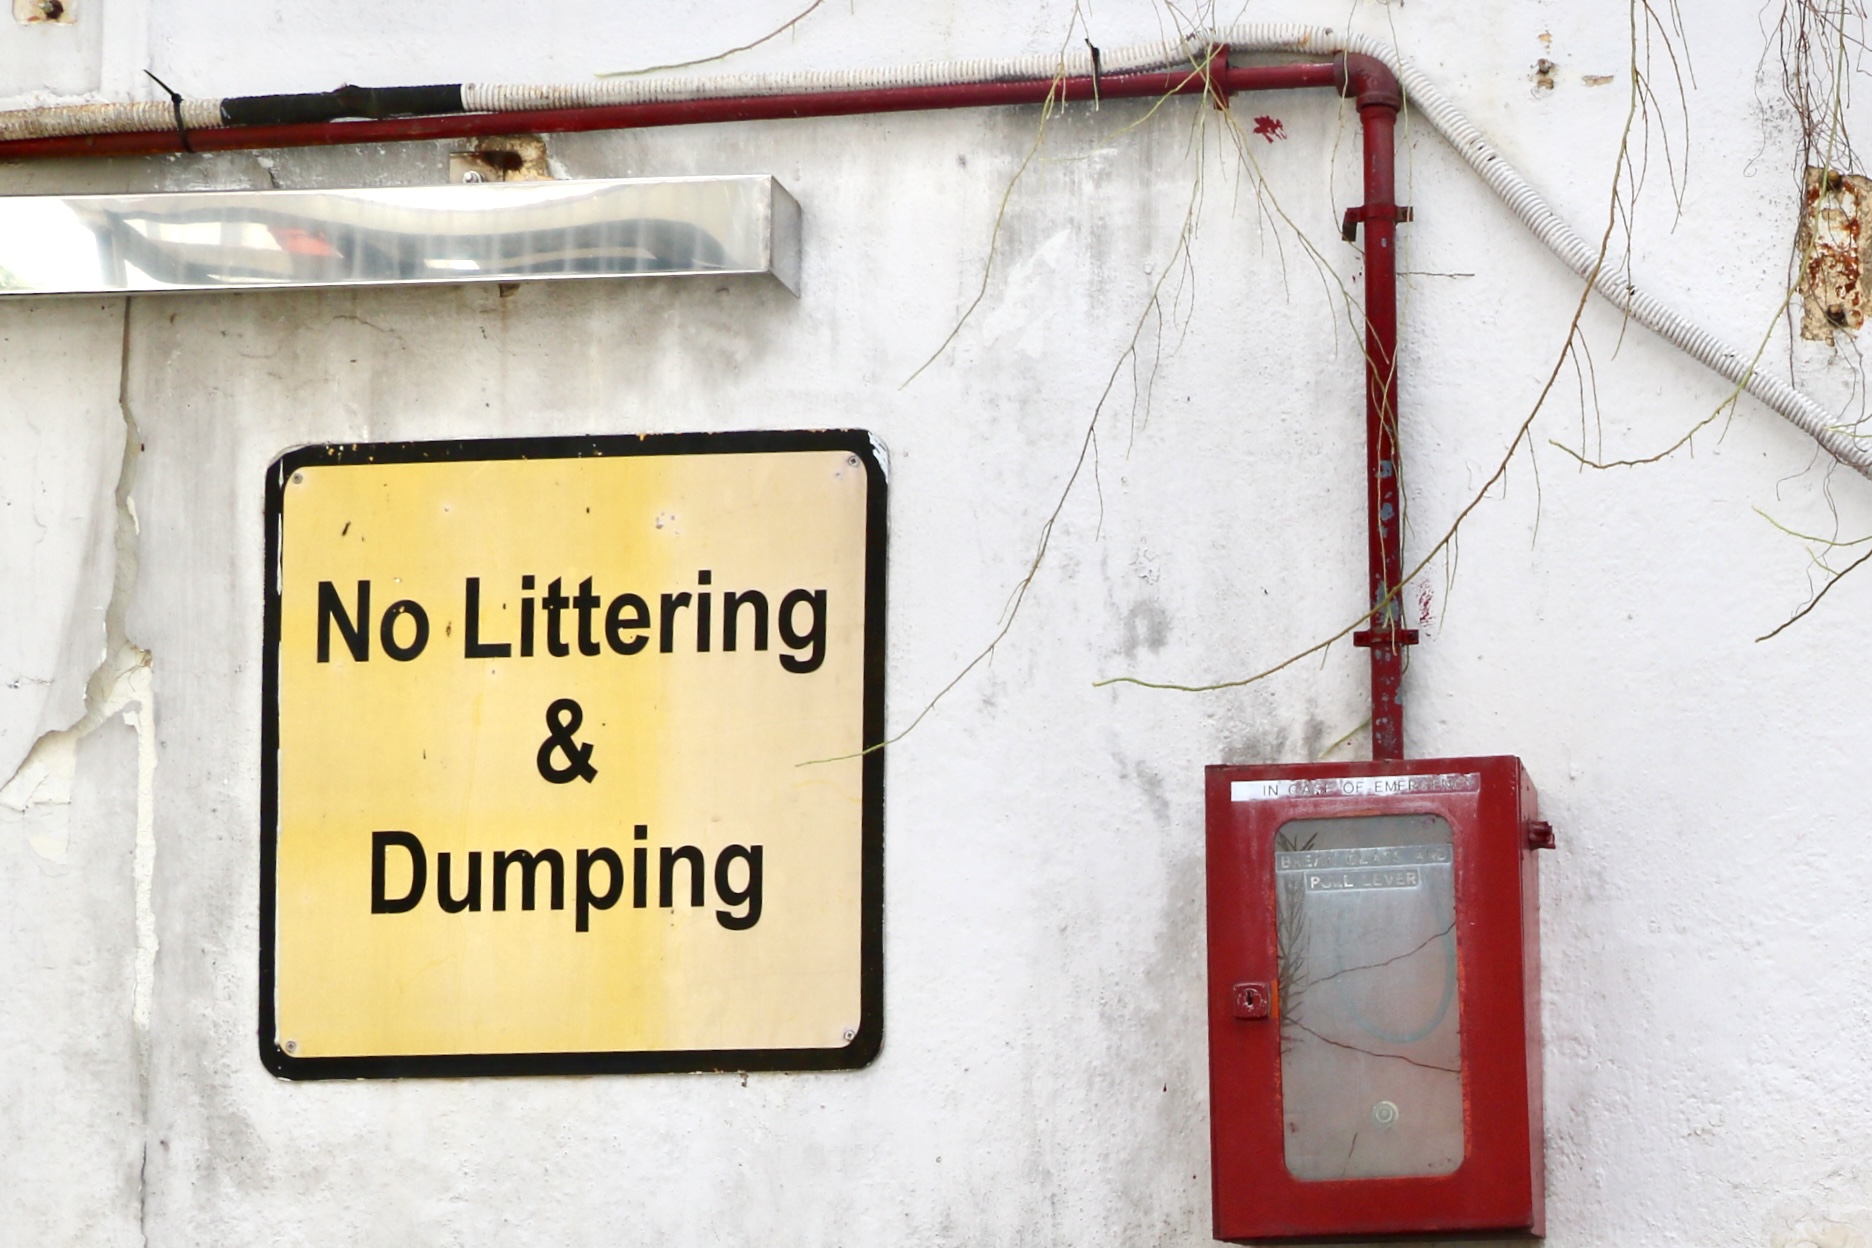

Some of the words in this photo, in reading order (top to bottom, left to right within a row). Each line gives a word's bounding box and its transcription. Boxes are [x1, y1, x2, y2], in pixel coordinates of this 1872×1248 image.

[317, 580, 429, 663] No
[464, 570, 828, 674] Littering
[536, 698, 598, 784] &
[1263, 784, 1279, 796] IN
[1288, 783, 1333, 796] CASE
[1343, 781, 1365, 794] OF
[371, 824, 764, 931] Dumping
